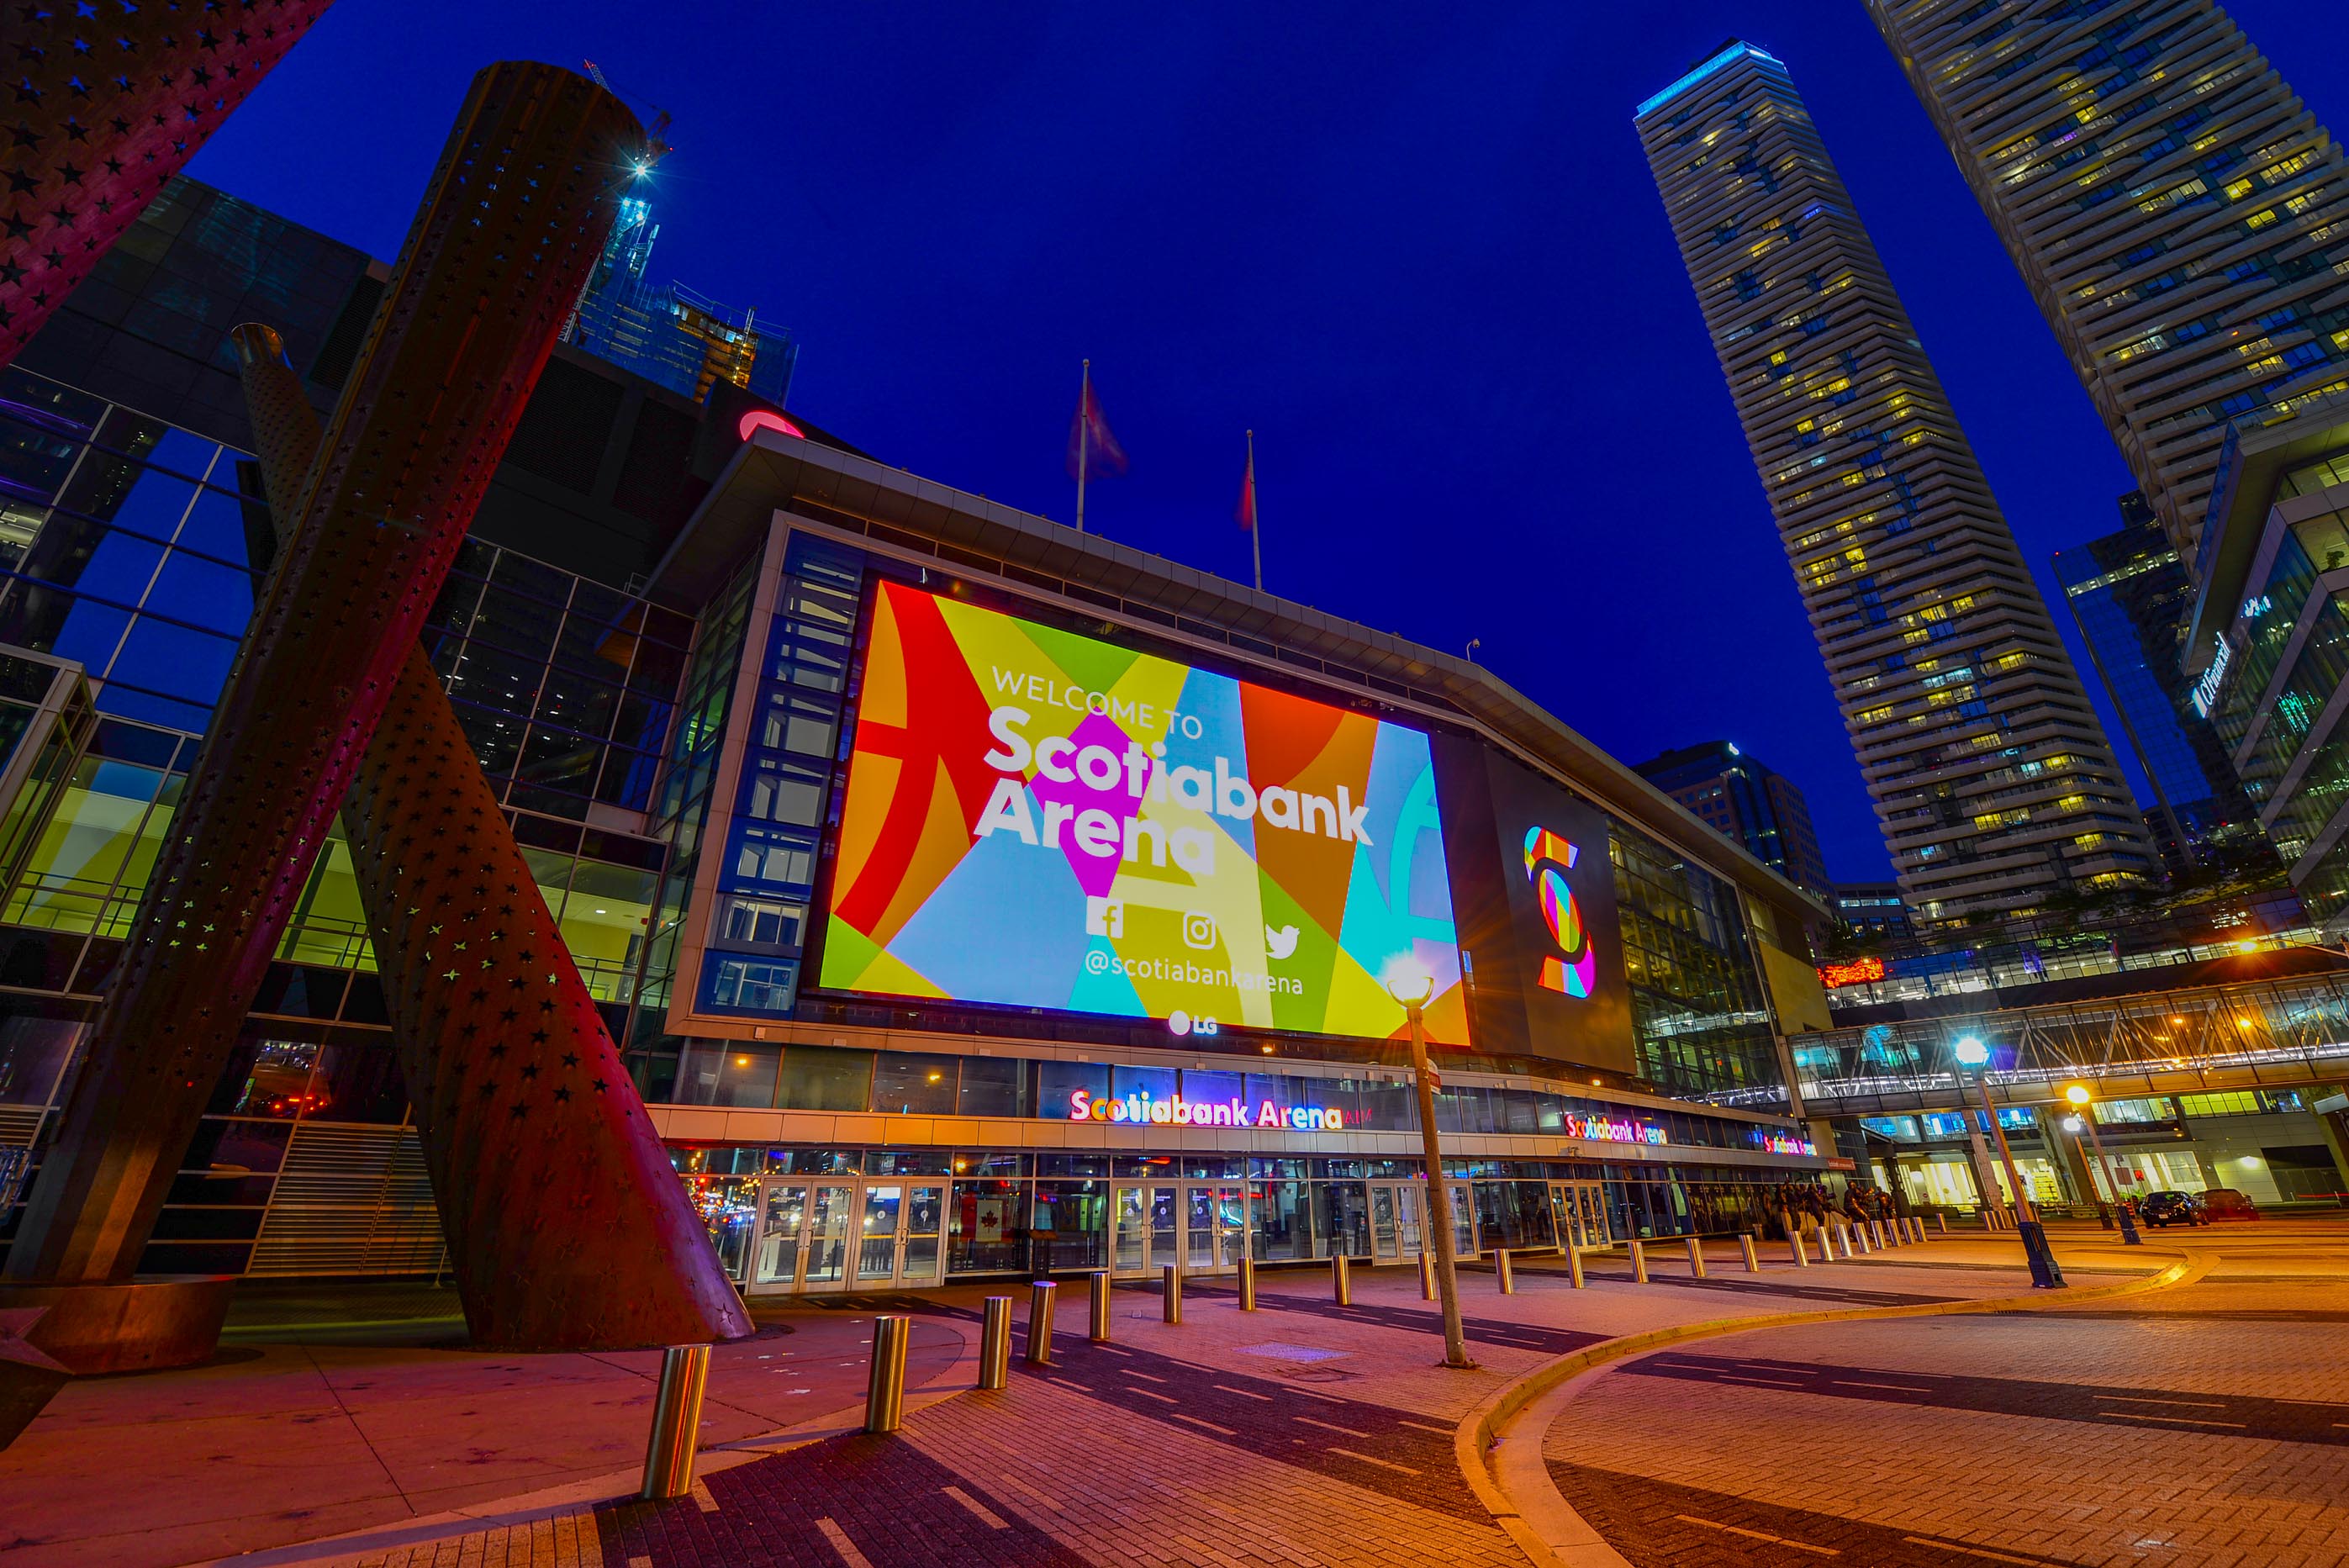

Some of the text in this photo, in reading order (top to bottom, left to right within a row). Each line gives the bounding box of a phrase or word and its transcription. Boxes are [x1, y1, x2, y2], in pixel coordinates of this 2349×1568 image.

[992, 665, 1202, 740] WELCOME TO
[983, 705, 1375, 847] Scotiabank
[974, 777, 1215, 876] Arena
[1085, 949, 1303, 995] @scotiabankarena
[1192, 1015, 1218, 1035] LG
[1070, 1090, 1343, 1130] Scotiabank Arena
[1565, 1114, 1668, 1144] Scotiabank Arena
